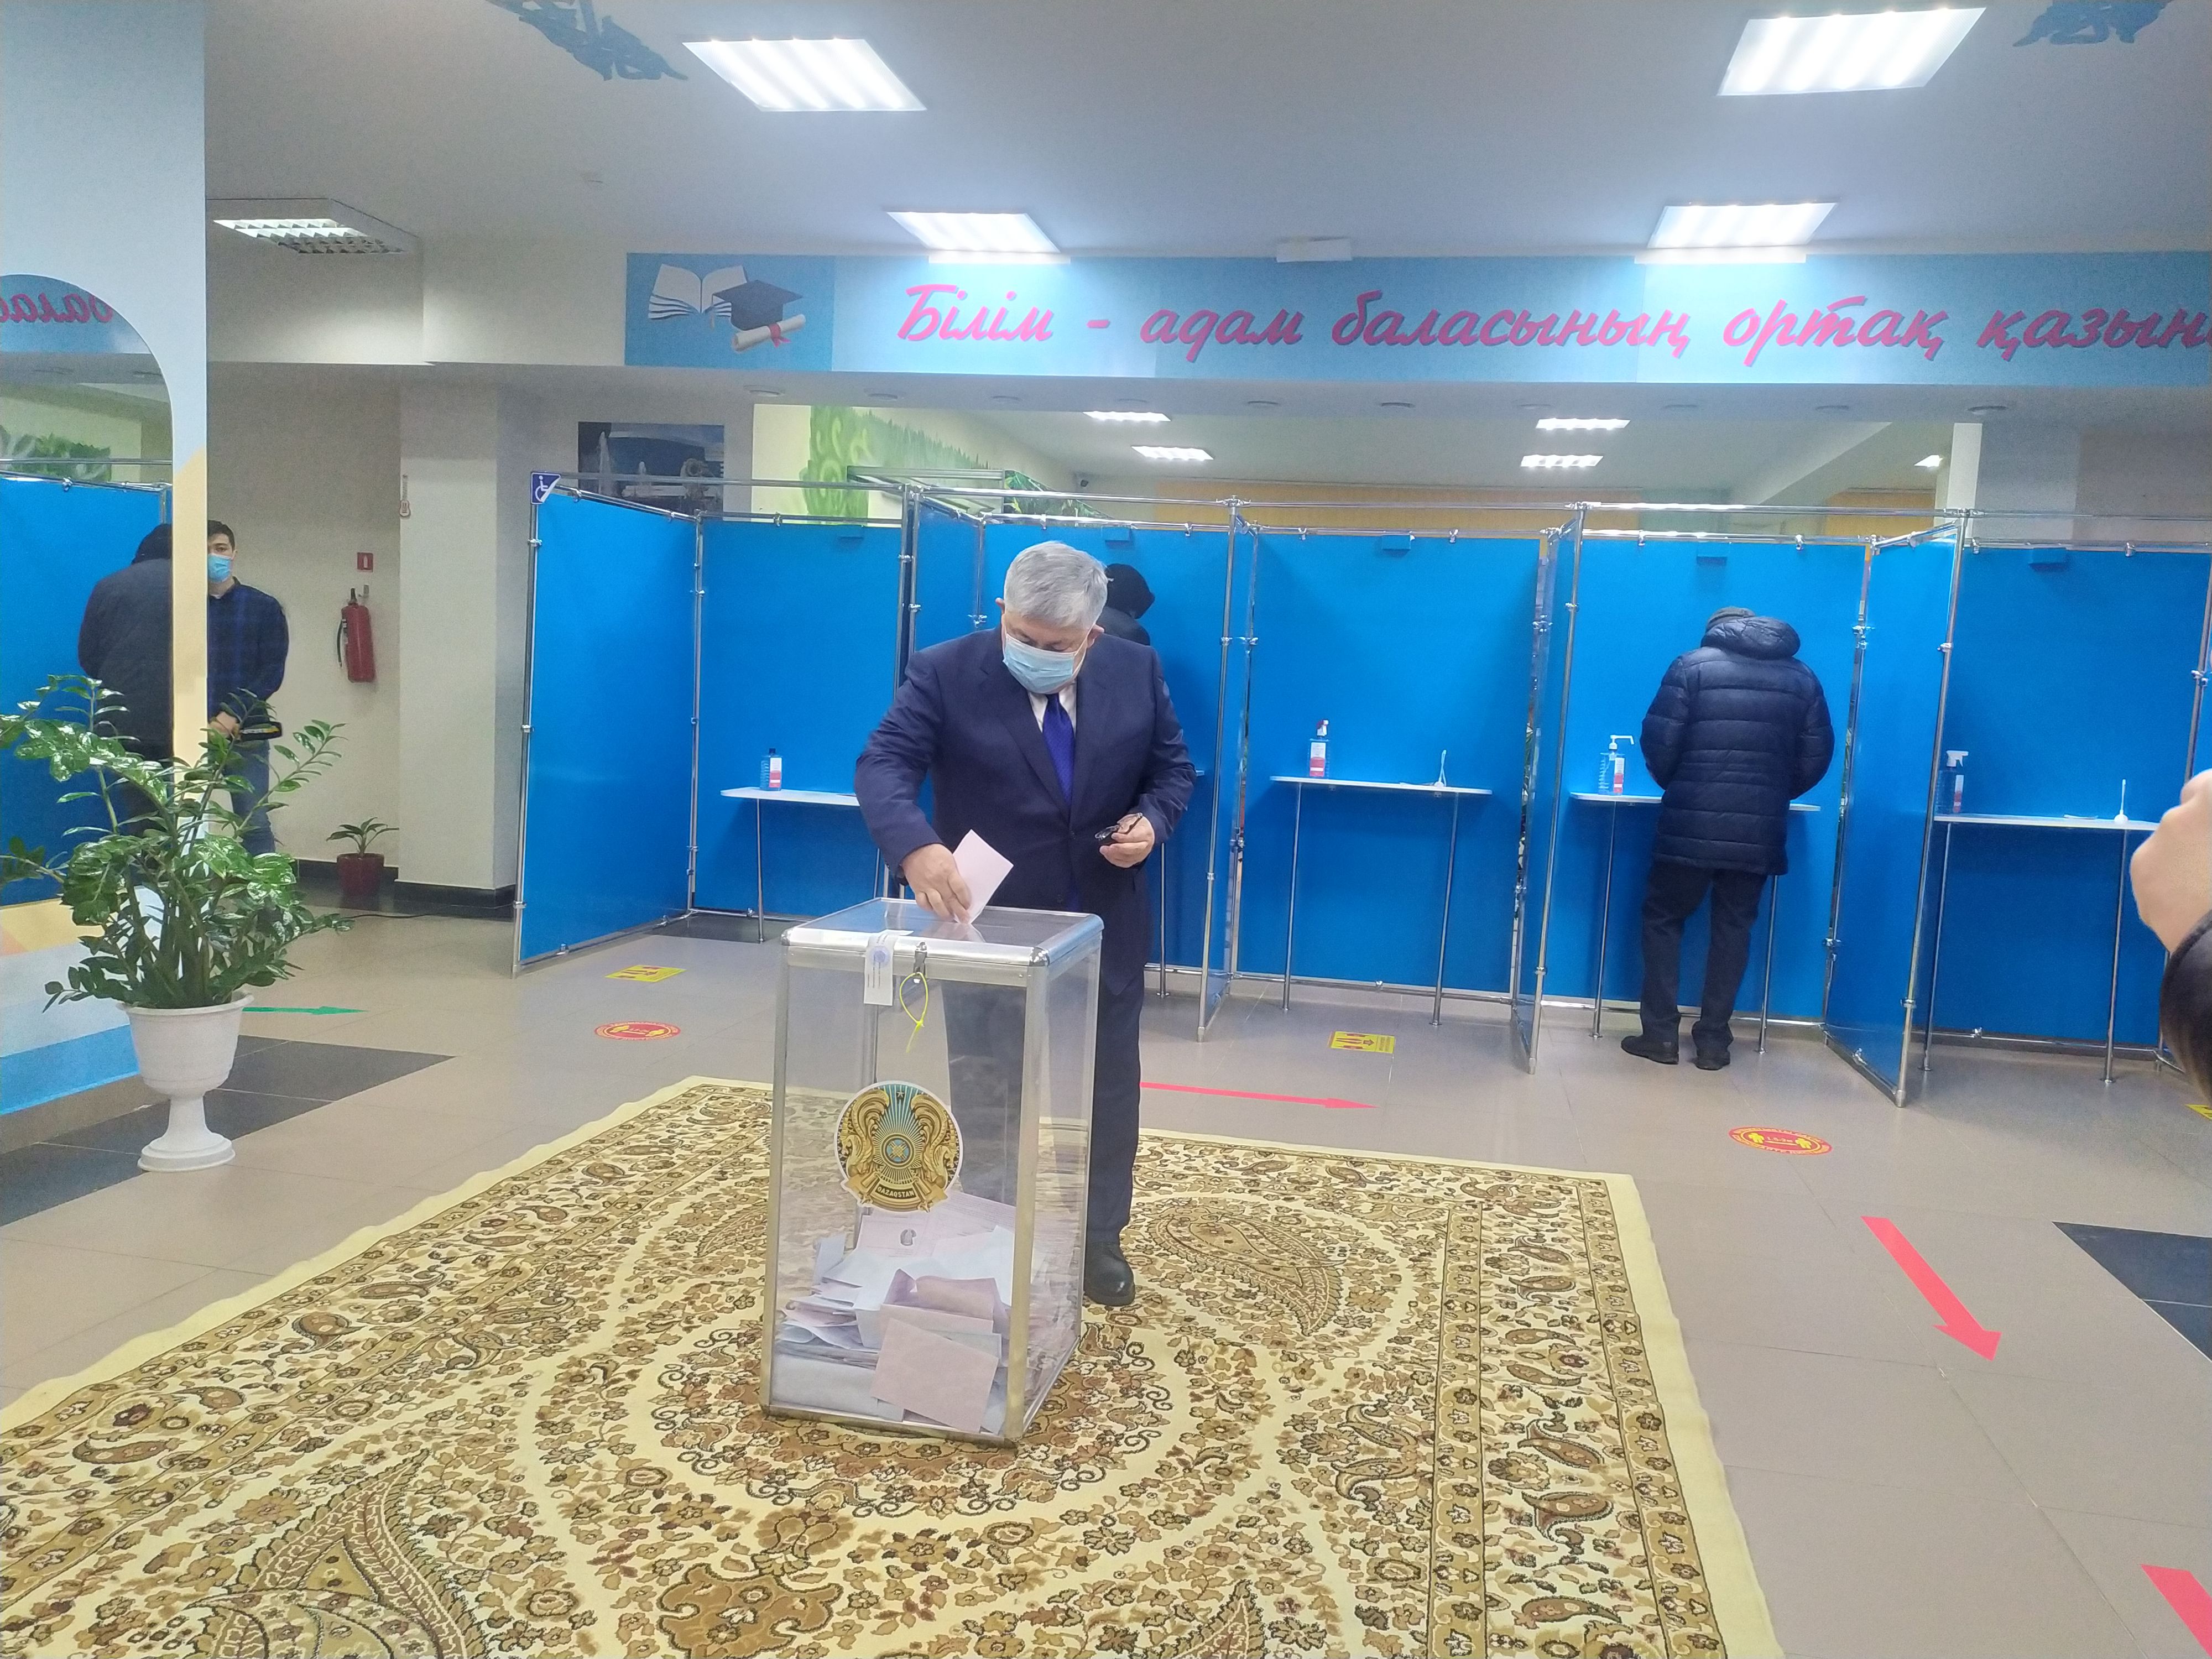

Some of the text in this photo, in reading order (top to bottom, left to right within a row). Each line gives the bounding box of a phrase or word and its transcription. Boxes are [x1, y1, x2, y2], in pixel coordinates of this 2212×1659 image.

[896, 283, 1055, 343] Білім
[1139, 308, 1303, 362] адам
[1331, 290, 1690, 359] баласының
[1721, 295, 1948, 367] ортақ
[1976, 307, 2212, 362] қазын
[877, 1186, 915, 1198] QAZAQSTAN
